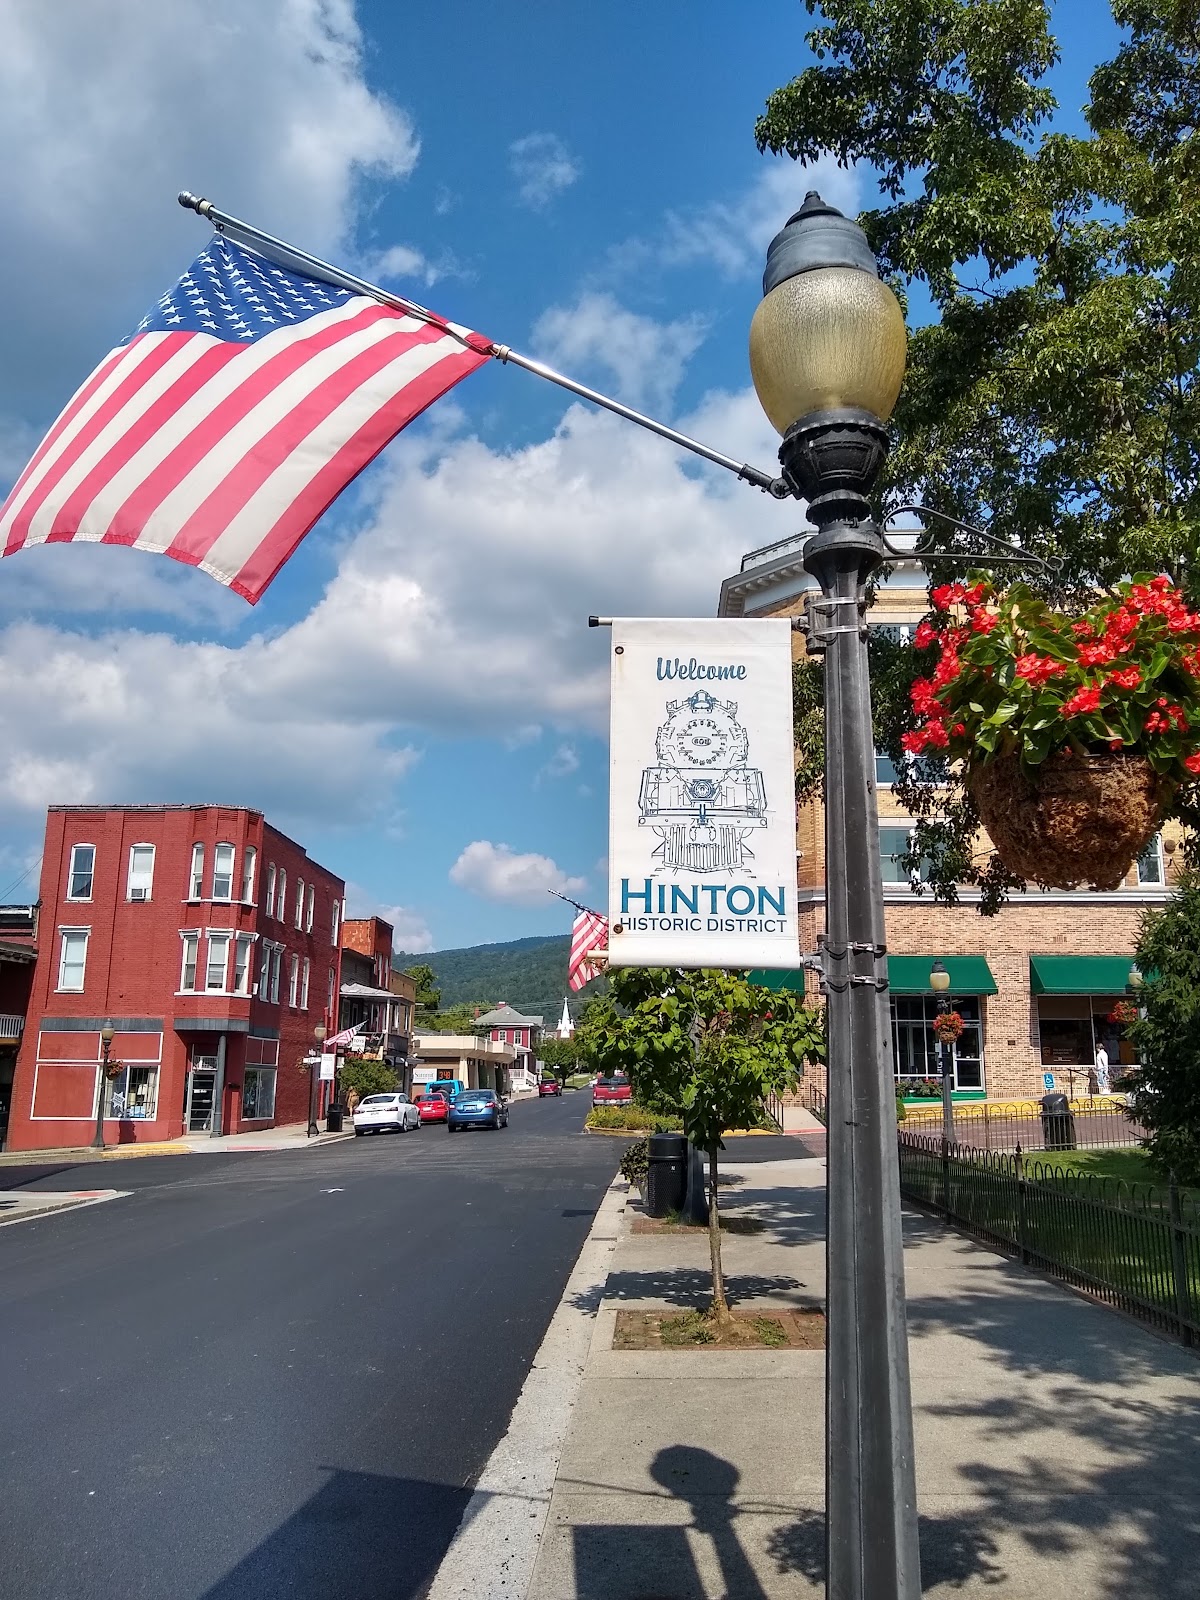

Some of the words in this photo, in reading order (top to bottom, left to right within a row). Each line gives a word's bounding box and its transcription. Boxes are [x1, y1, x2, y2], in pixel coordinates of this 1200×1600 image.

[656, 657, 748, 681] Welcome
[620, 878, 786, 916] HINTON
[620, 917, 701, 931] HISTORIC
[707, 918, 788, 933] DISTRICT
